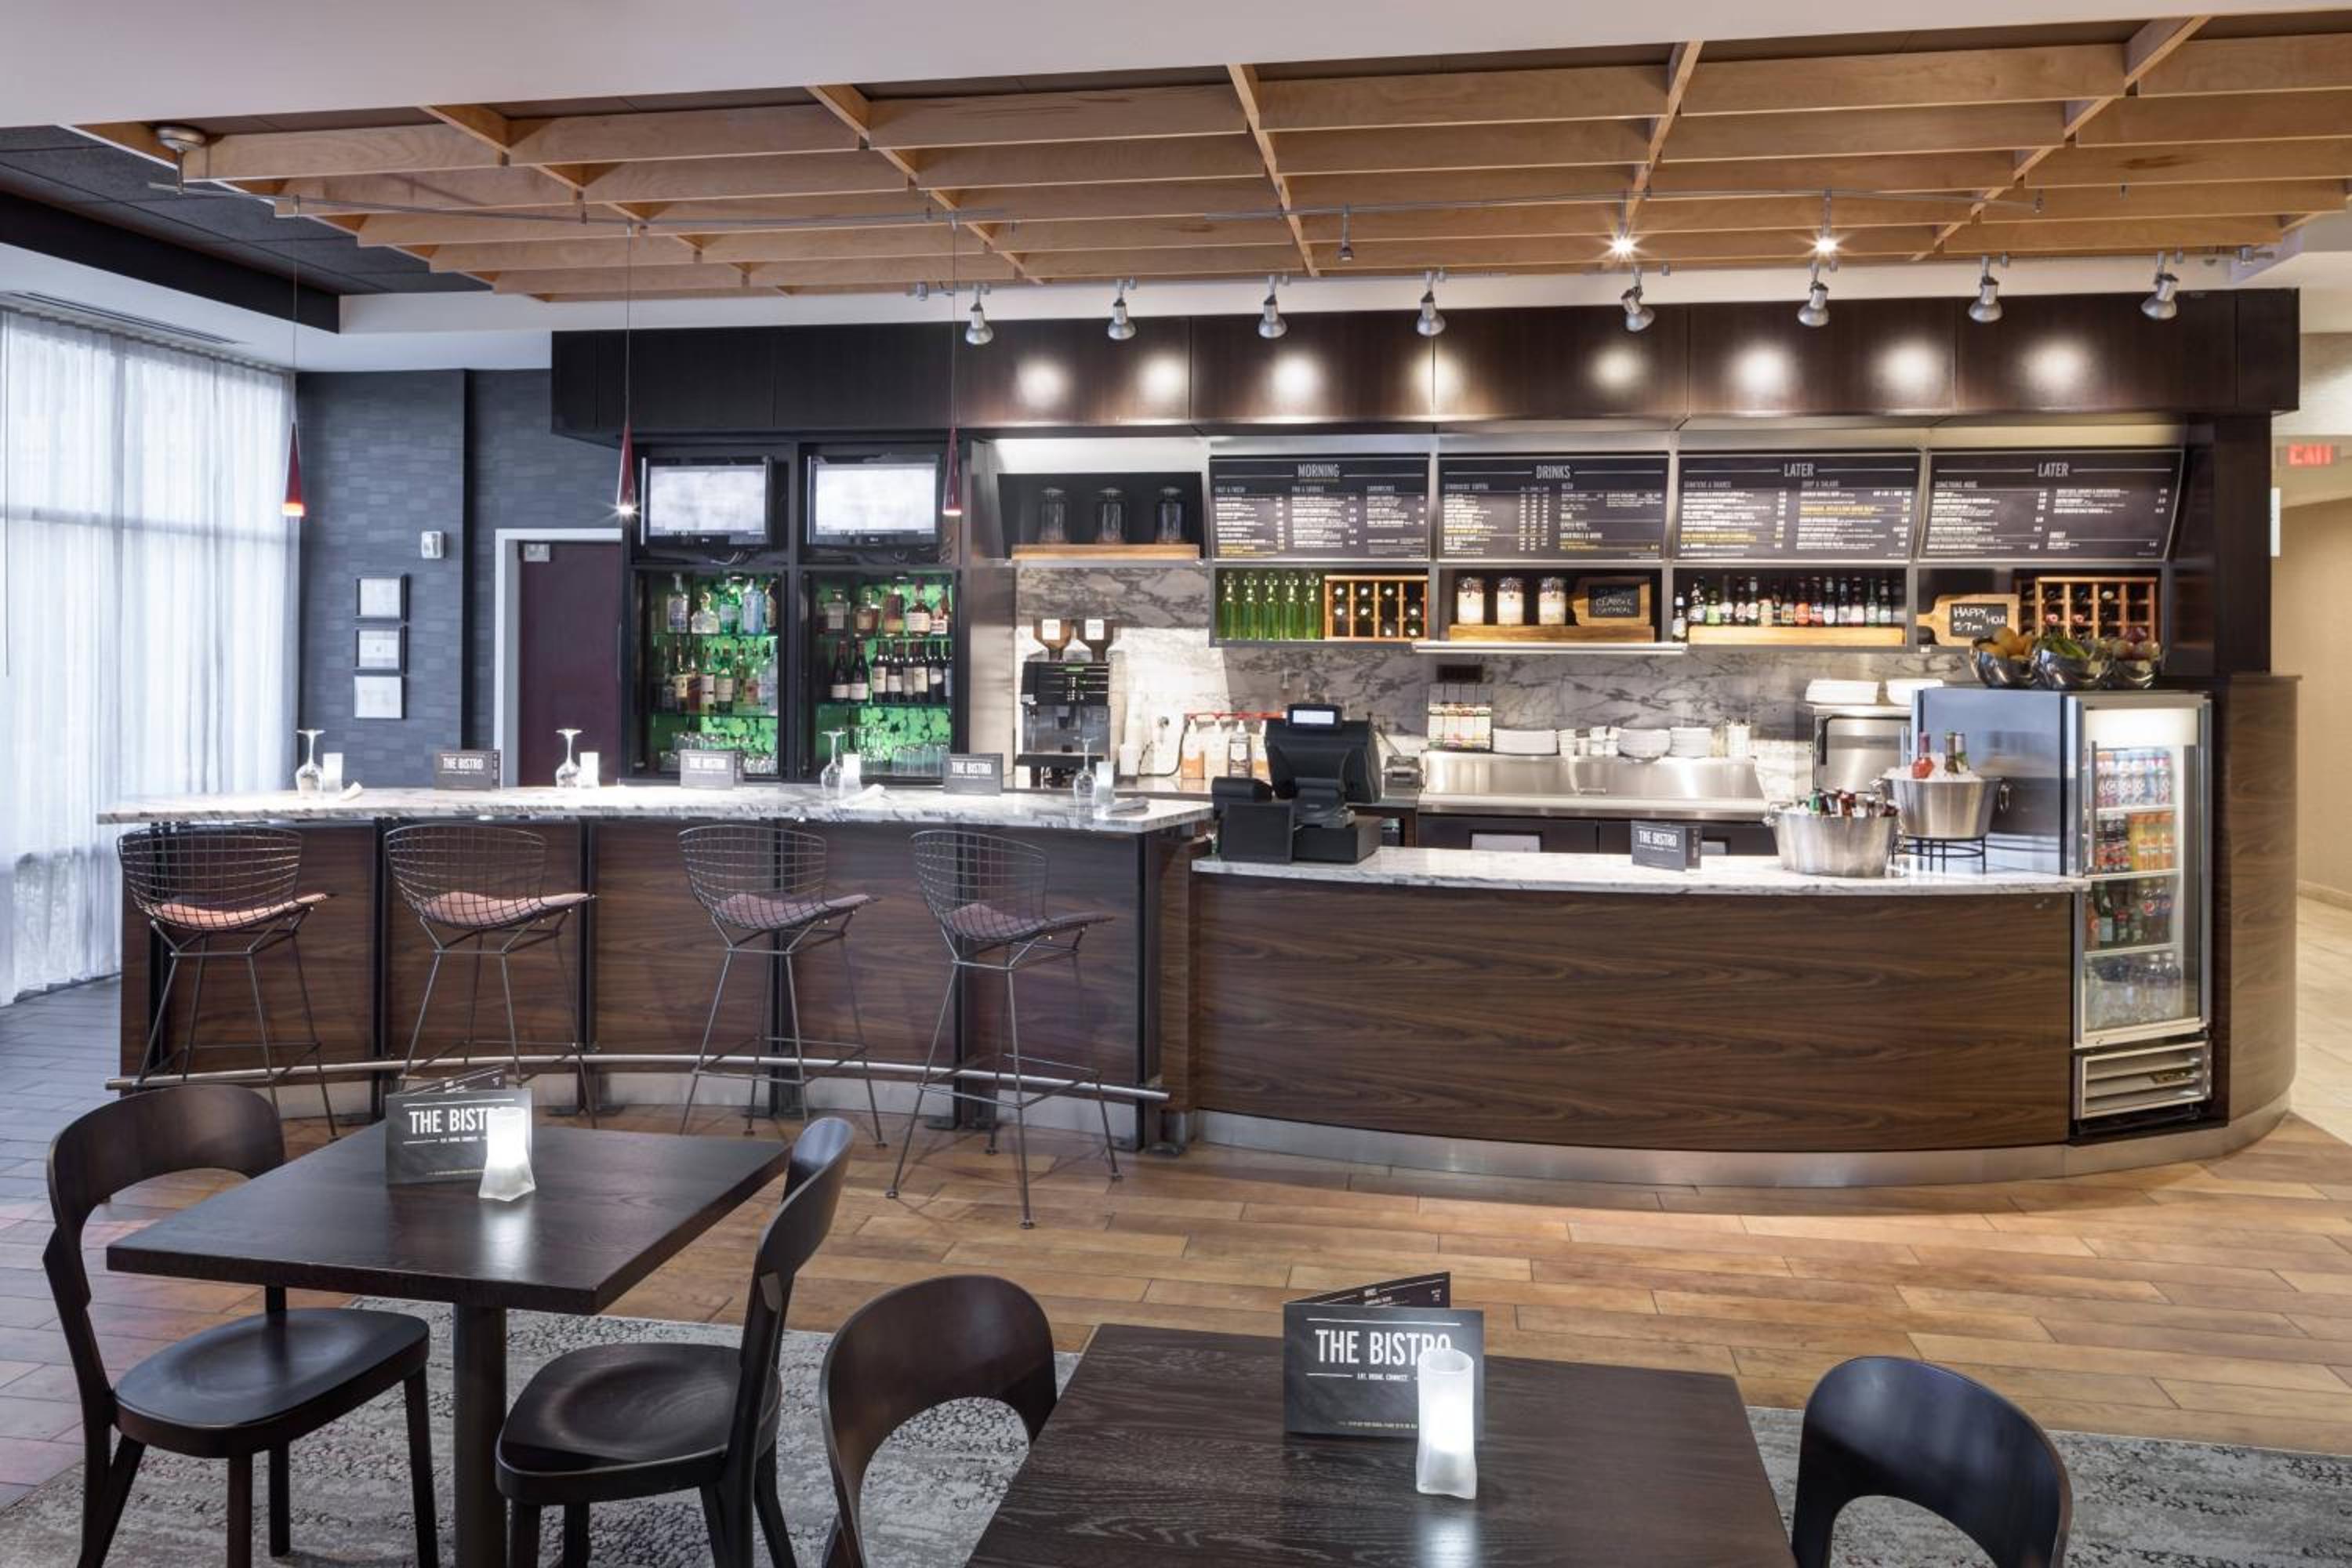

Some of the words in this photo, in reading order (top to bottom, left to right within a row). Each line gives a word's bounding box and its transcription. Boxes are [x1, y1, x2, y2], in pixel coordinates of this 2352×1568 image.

[1298, 463, 1340, 477] MORNING
[1536, 464, 1570, 479] DRINKS
[1784, 463, 1814, 477] LATER
[2038, 462, 2069, 477] LATER
[1953, 606, 1987, 618] HAPPY
[443, 757, 456, 769] THE
[458, 757, 484, 770] BISTRO
[952, 761, 966, 774] THE
[967, 762, 992, 775] BISTRO
[1639, 829, 1651, 844] THE
[1652, 831, 1677, 848] BISTRO
[408, 1109, 442, 1134] THE
[449, 1107, 487, 1132] BIST
[1315, 1329, 1360, 1364] THE
